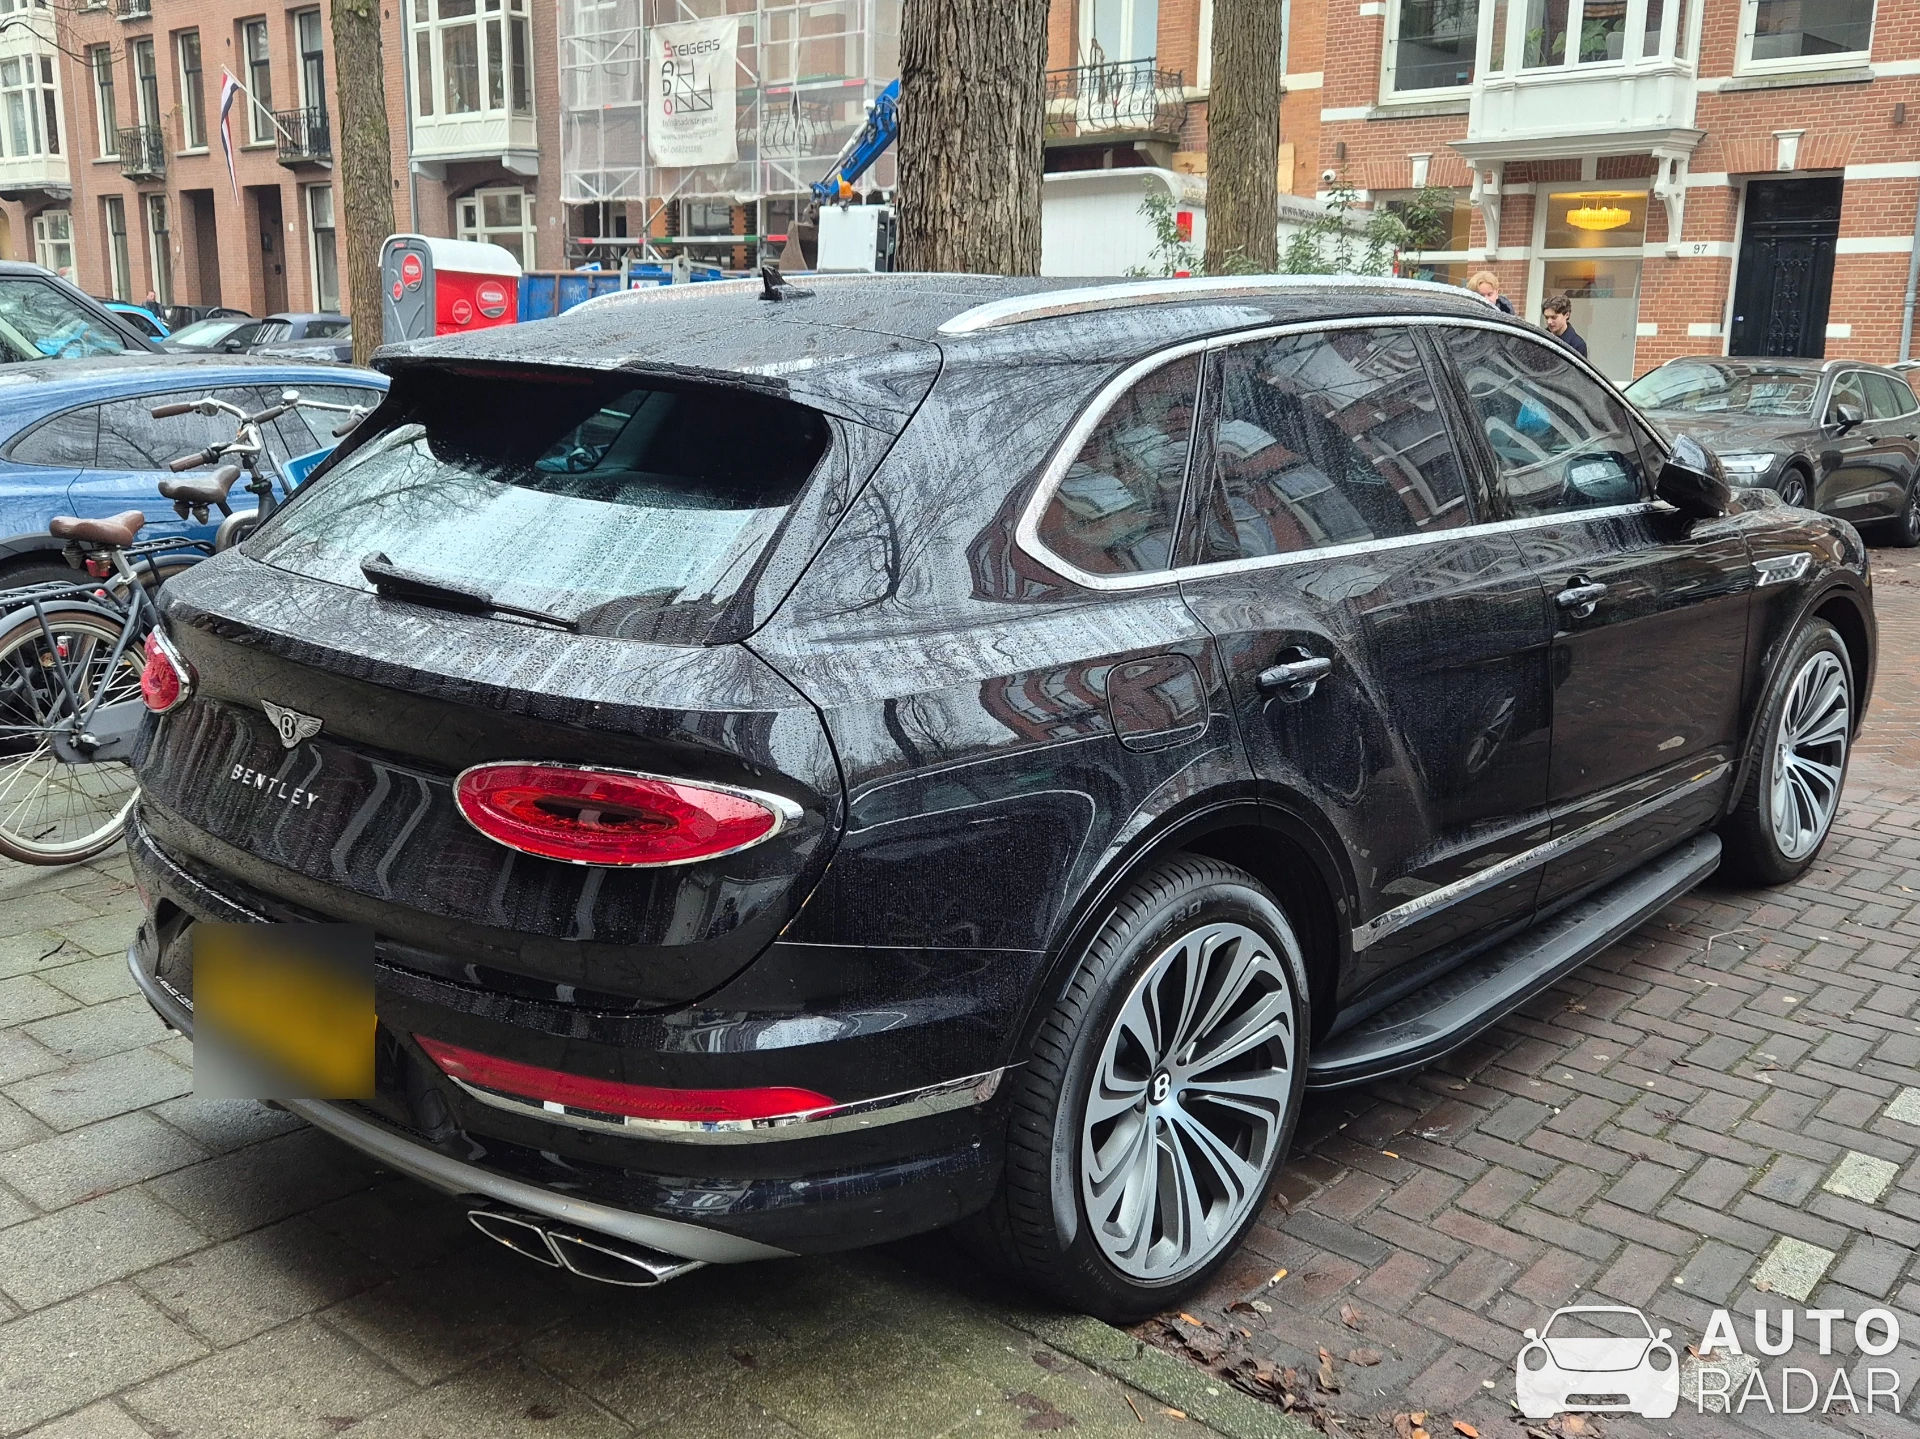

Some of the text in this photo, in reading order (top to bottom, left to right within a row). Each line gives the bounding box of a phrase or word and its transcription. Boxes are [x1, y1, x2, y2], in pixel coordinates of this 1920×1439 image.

[1693, 244, 1708, 255] 97
[230, 764, 319, 810] BENTLEY
[1153, 1073, 1171, 1101] B
